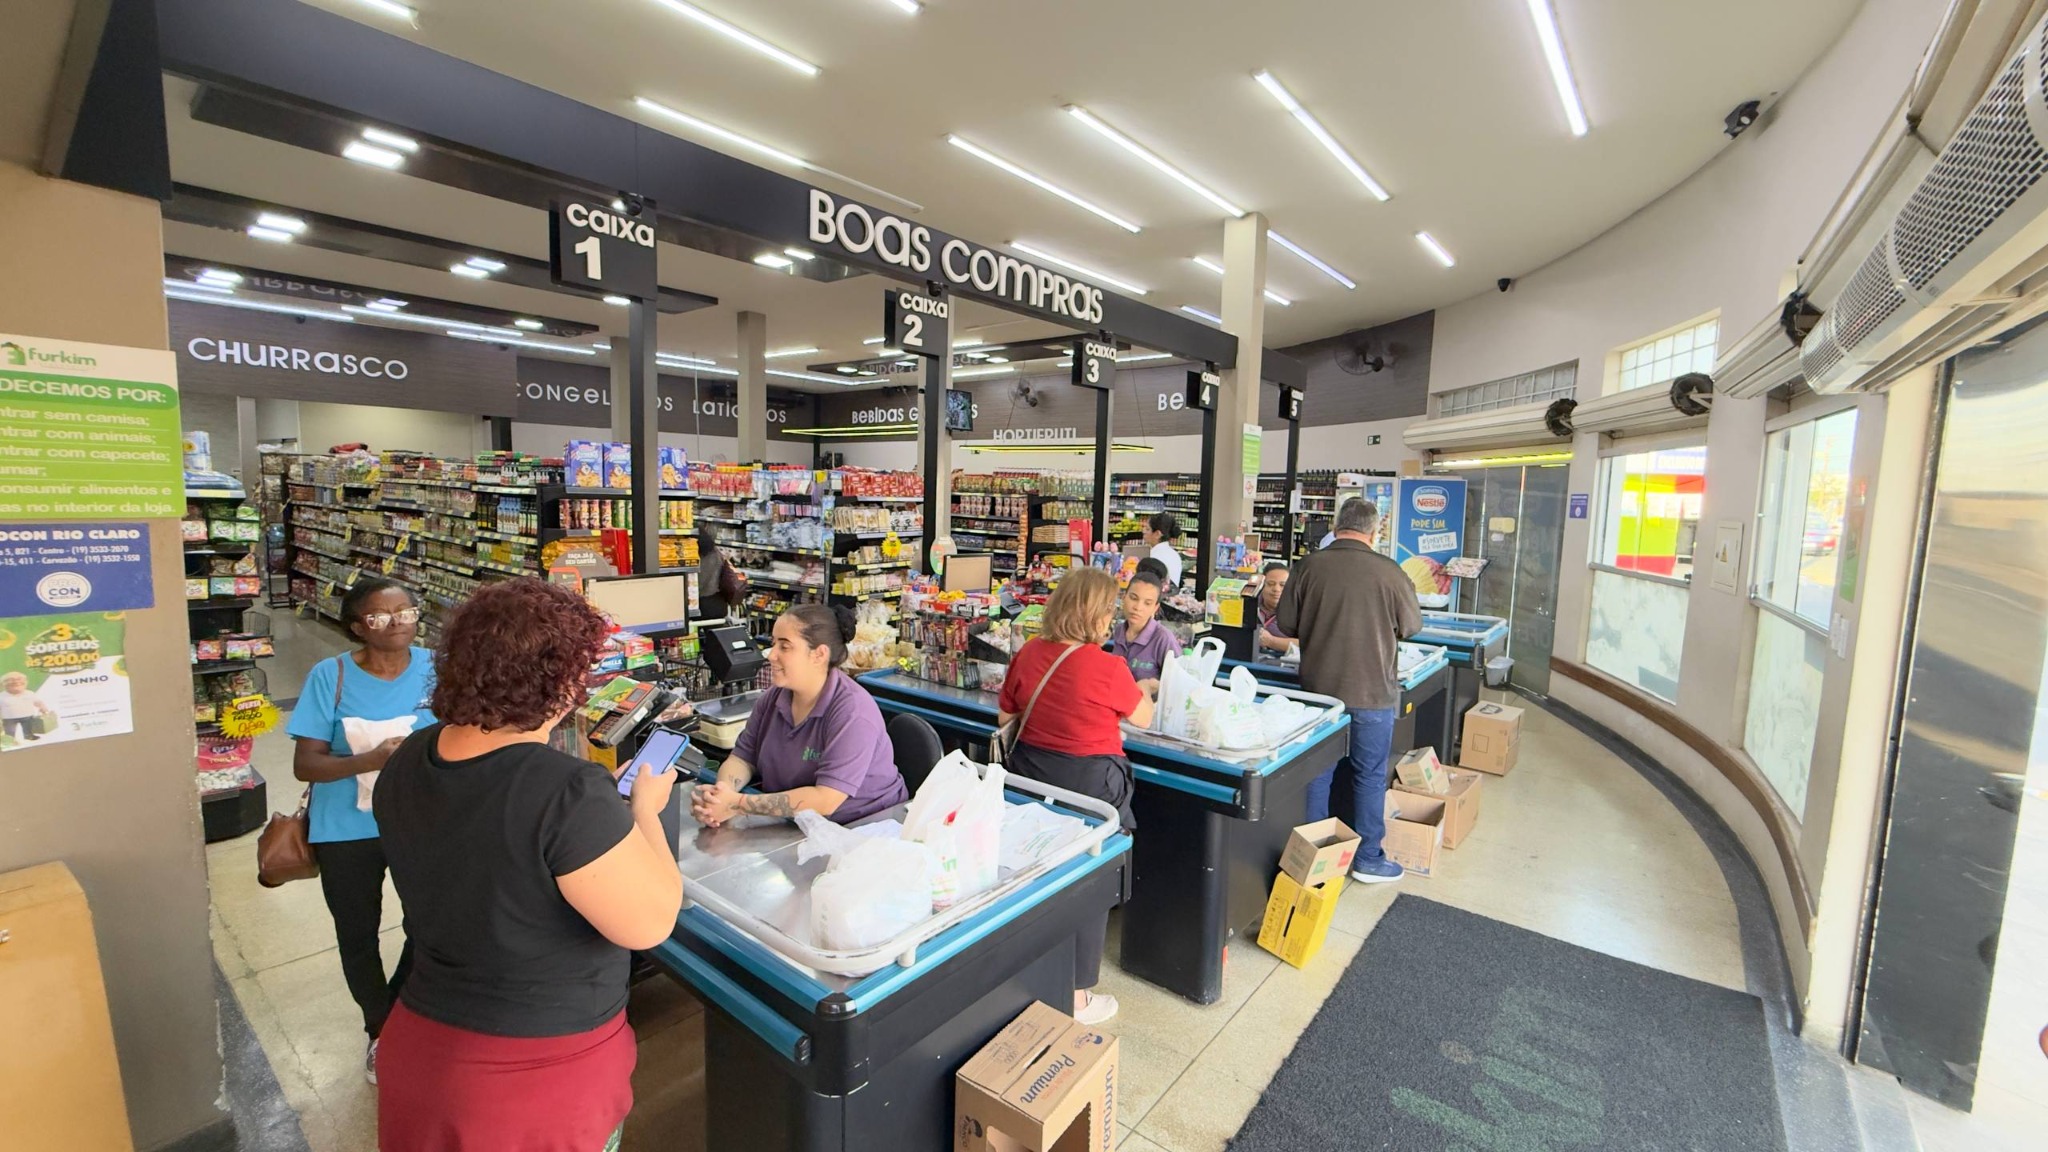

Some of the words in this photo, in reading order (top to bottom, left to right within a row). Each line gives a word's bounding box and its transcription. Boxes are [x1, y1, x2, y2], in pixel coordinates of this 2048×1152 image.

[566, 203, 655, 248] caixa
[575, 236, 602, 280] 1
[899, 292, 948, 318] caixa
[903, 314, 923, 346] 2
[28, 347, 97, 366] furkim
[1085, 341, 1117, 361] caixa
[1086, 360, 1100, 383] 3
[117, 387, 167, 403] POR:
[1202, 385, 1211, 405] 4
[1291, 400, 1298, 417] 5
[44, 411, 81, 421] sem
[86, 412, 149, 427] camisa;
[45, 429, 84, 440] com
[88, 431, 156, 444] animais;
[47, 448, 85, 458] com
[90, 450, 170, 462] capacete;
[79, 483, 157, 495] alimentos
[162, 486, 172, 495] e
[27, 504, 49, 512] no
[55, 502, 115, 512] interior
[120, 503, 141, 512] da
[145, 503, 176, 514] loja.
[53, 530, 84, 540] RIO
[89, 529, 140, 540] CLARO
[48, 588, 81, 596] CON
[51, 624, 72, 641] 3
[25, 640, 100, 656] SORTEIOS
[62, 675, 109, 687] JUNHO
[1020, 1054, 1075, 1104] Premium
